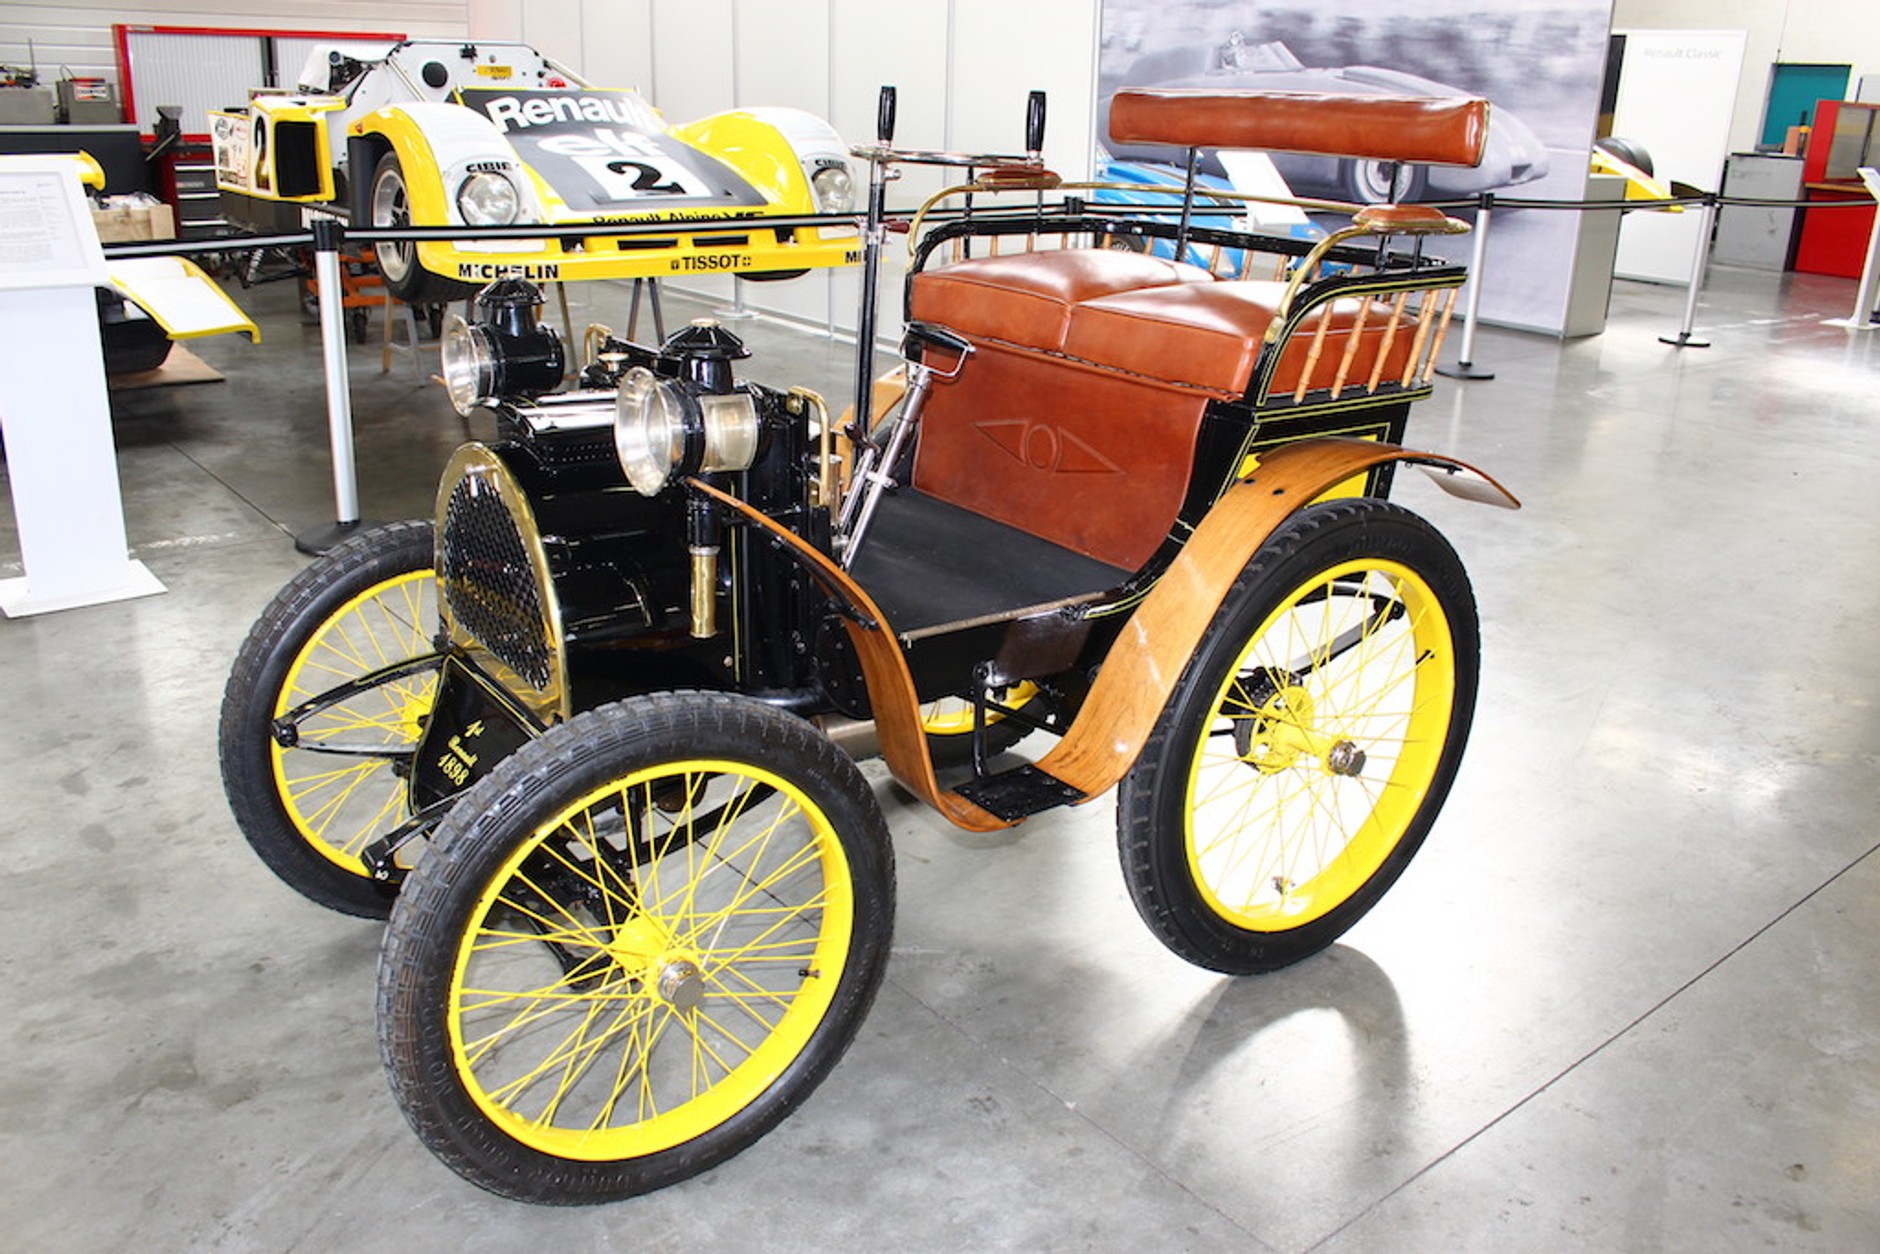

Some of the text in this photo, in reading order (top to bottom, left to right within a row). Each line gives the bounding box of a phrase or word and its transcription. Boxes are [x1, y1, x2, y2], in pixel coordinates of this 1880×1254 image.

[485, 96, 657, 134] Renault
[537, 128, 668, 156] elf
[606, 161, 687, 195] 2
[681, 254, 742, 271] TISSOT
[437, 753, 470, 786] 1898
